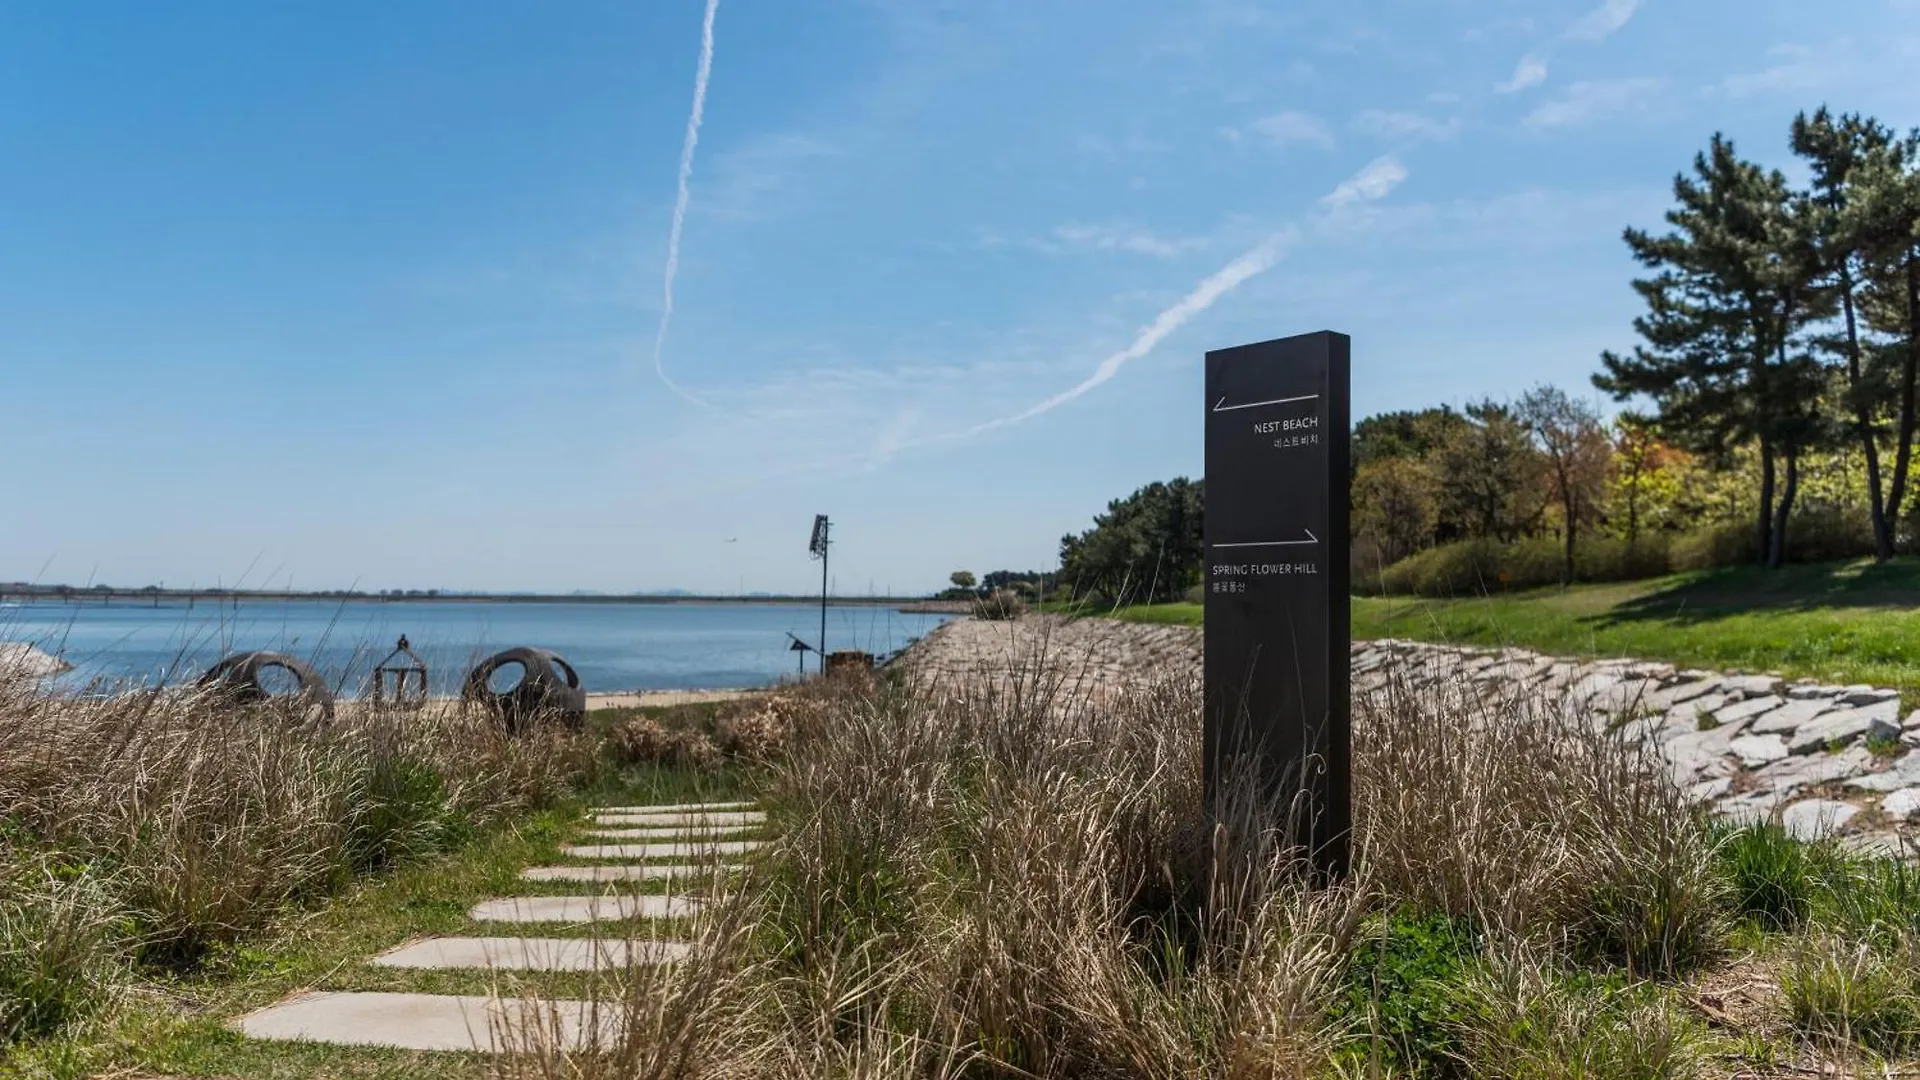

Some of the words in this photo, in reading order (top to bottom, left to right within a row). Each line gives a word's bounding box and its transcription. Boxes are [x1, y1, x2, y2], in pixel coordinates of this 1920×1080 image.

[1254, 421, 1280, 433] NEST
[1283, 417, 1318, 430] BEACH
[1212, 565, 1248, 575] SPRING
[1251, 564, 1291, 574] FLOWER
[1294, 563, 1317, 574] HILL
